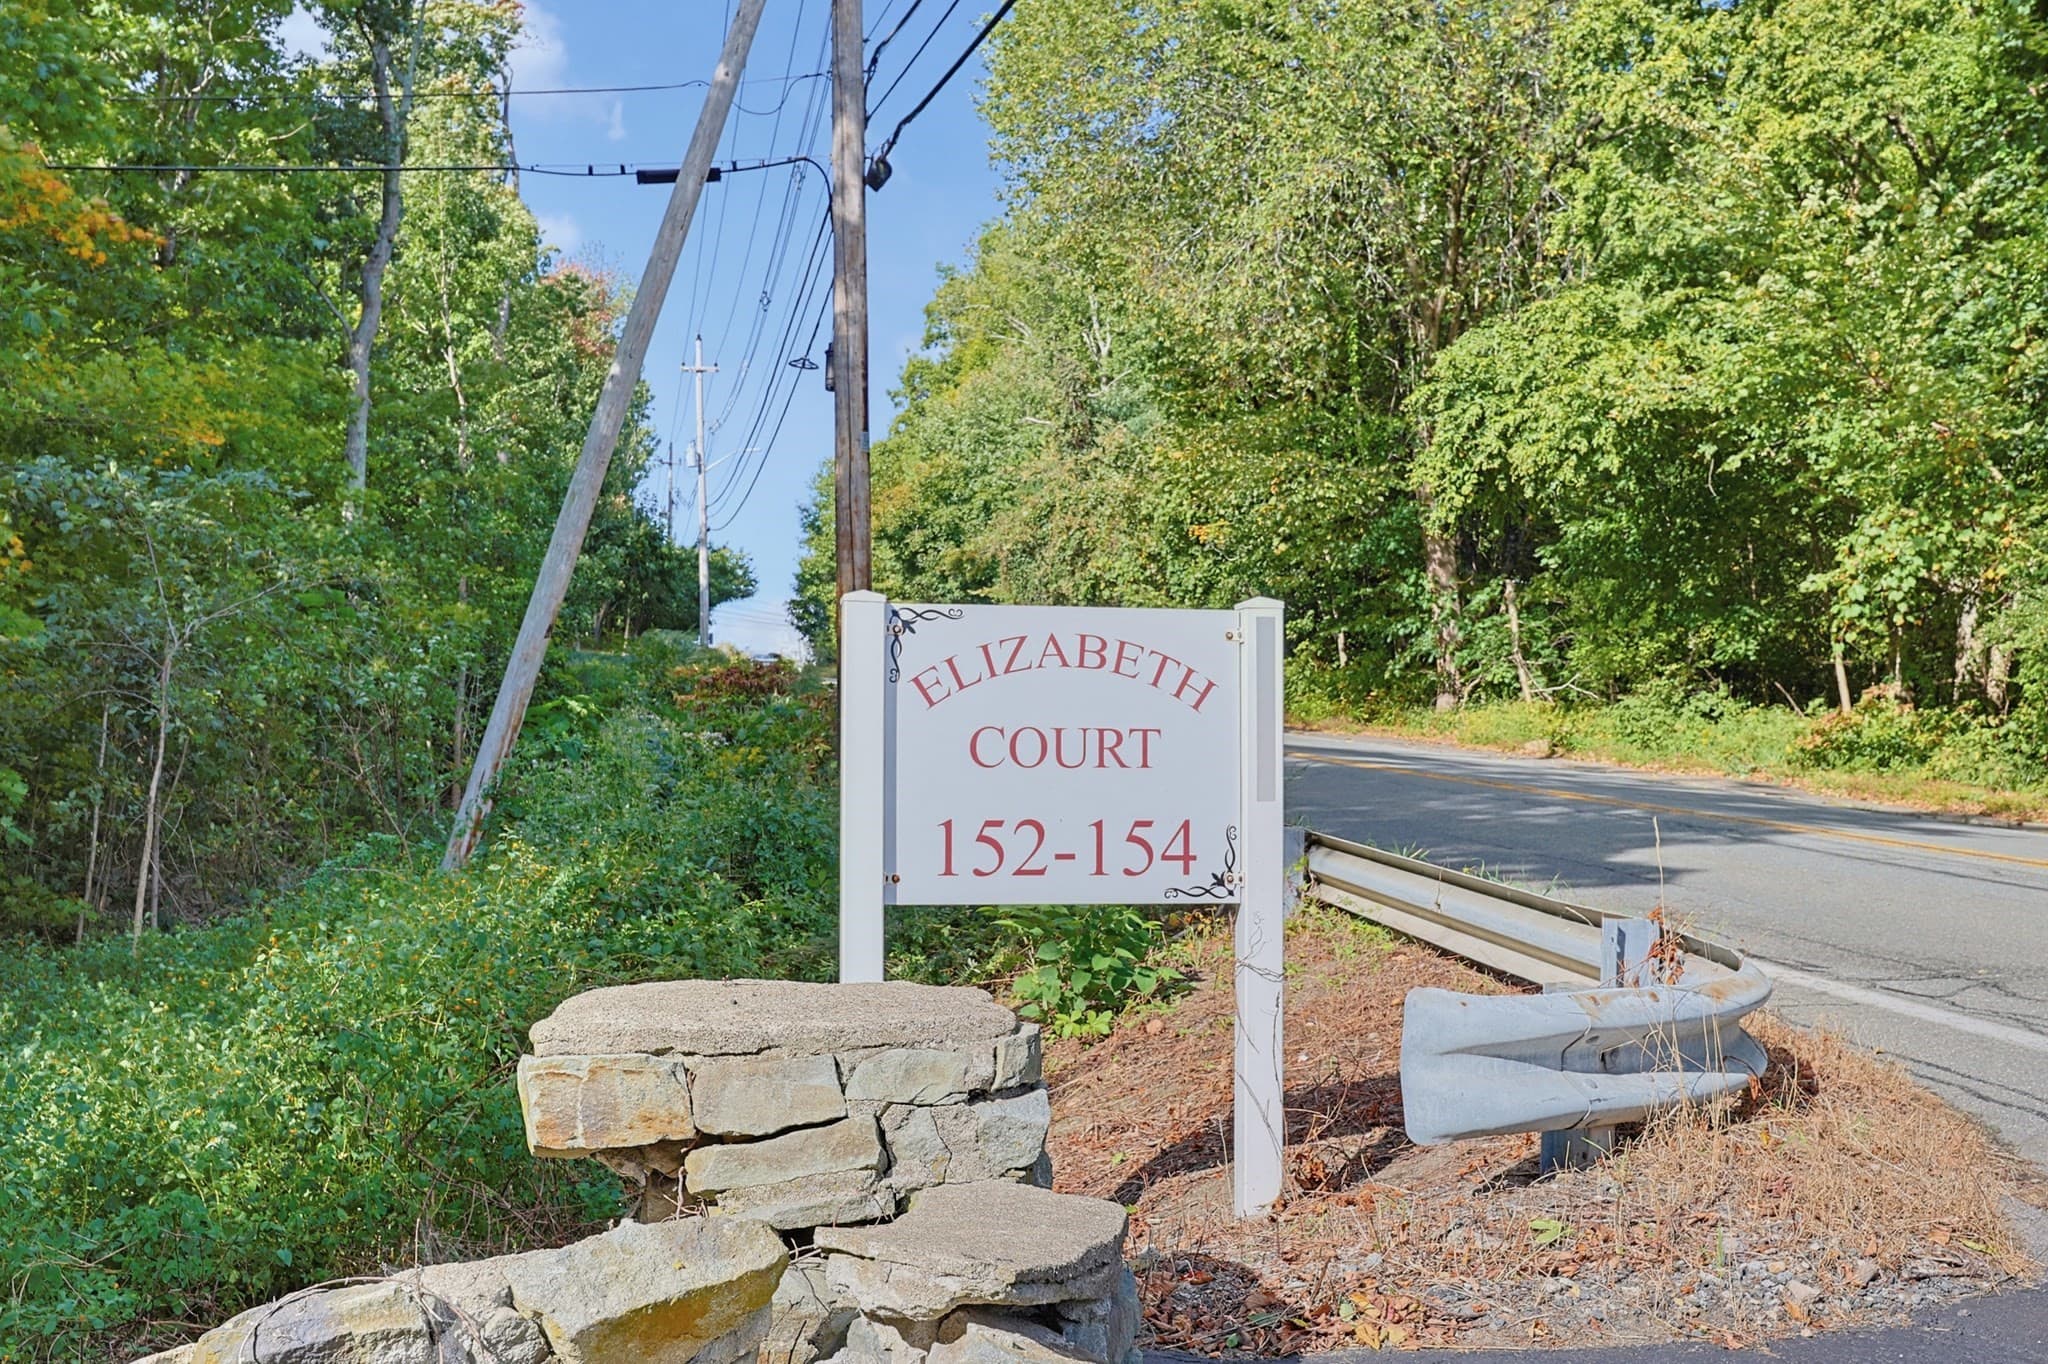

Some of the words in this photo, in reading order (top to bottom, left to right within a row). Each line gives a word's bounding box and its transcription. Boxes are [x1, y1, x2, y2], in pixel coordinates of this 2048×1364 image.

[908, 632, 1219, 713] ELIZABETH
[969, 726, 1162, 769] COURT
[937, 818, 1198, 877] 152-154
